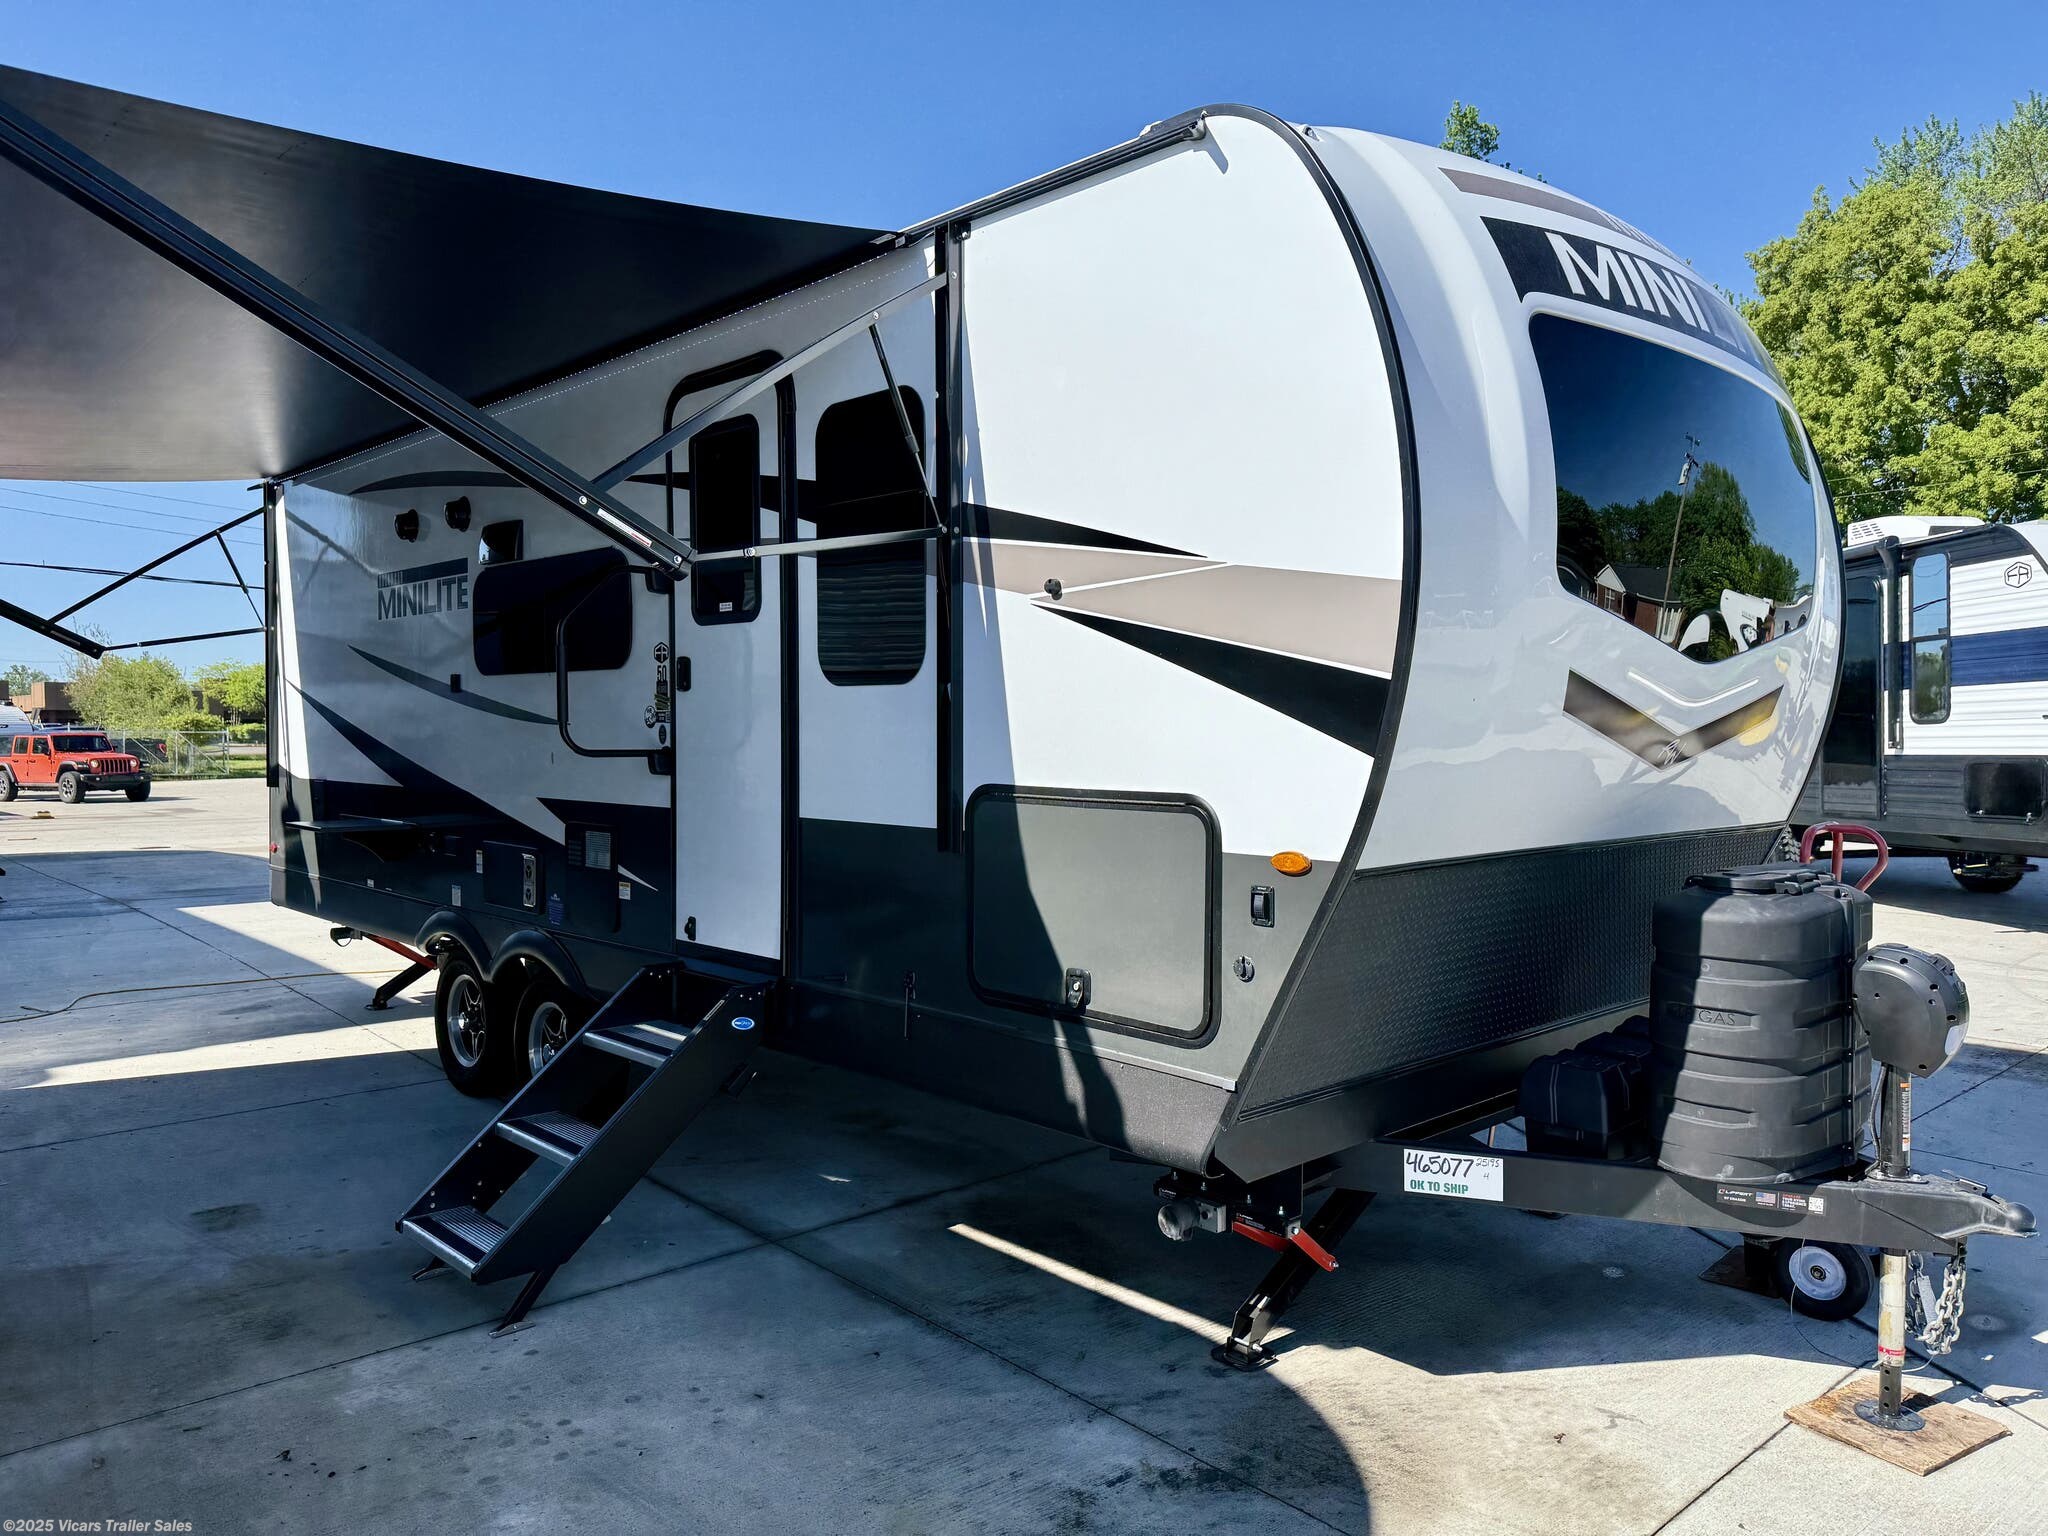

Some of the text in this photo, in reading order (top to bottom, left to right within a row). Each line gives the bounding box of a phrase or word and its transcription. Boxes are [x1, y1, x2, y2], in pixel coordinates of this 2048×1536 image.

[378, 575, 468, 620] MINILITE
[1698, 1010, 1736, 1026] GAS
[1406, 1152, 1475, 1178] 465077
[1410, 1179, 1469, 1194] OK TO SHIP
